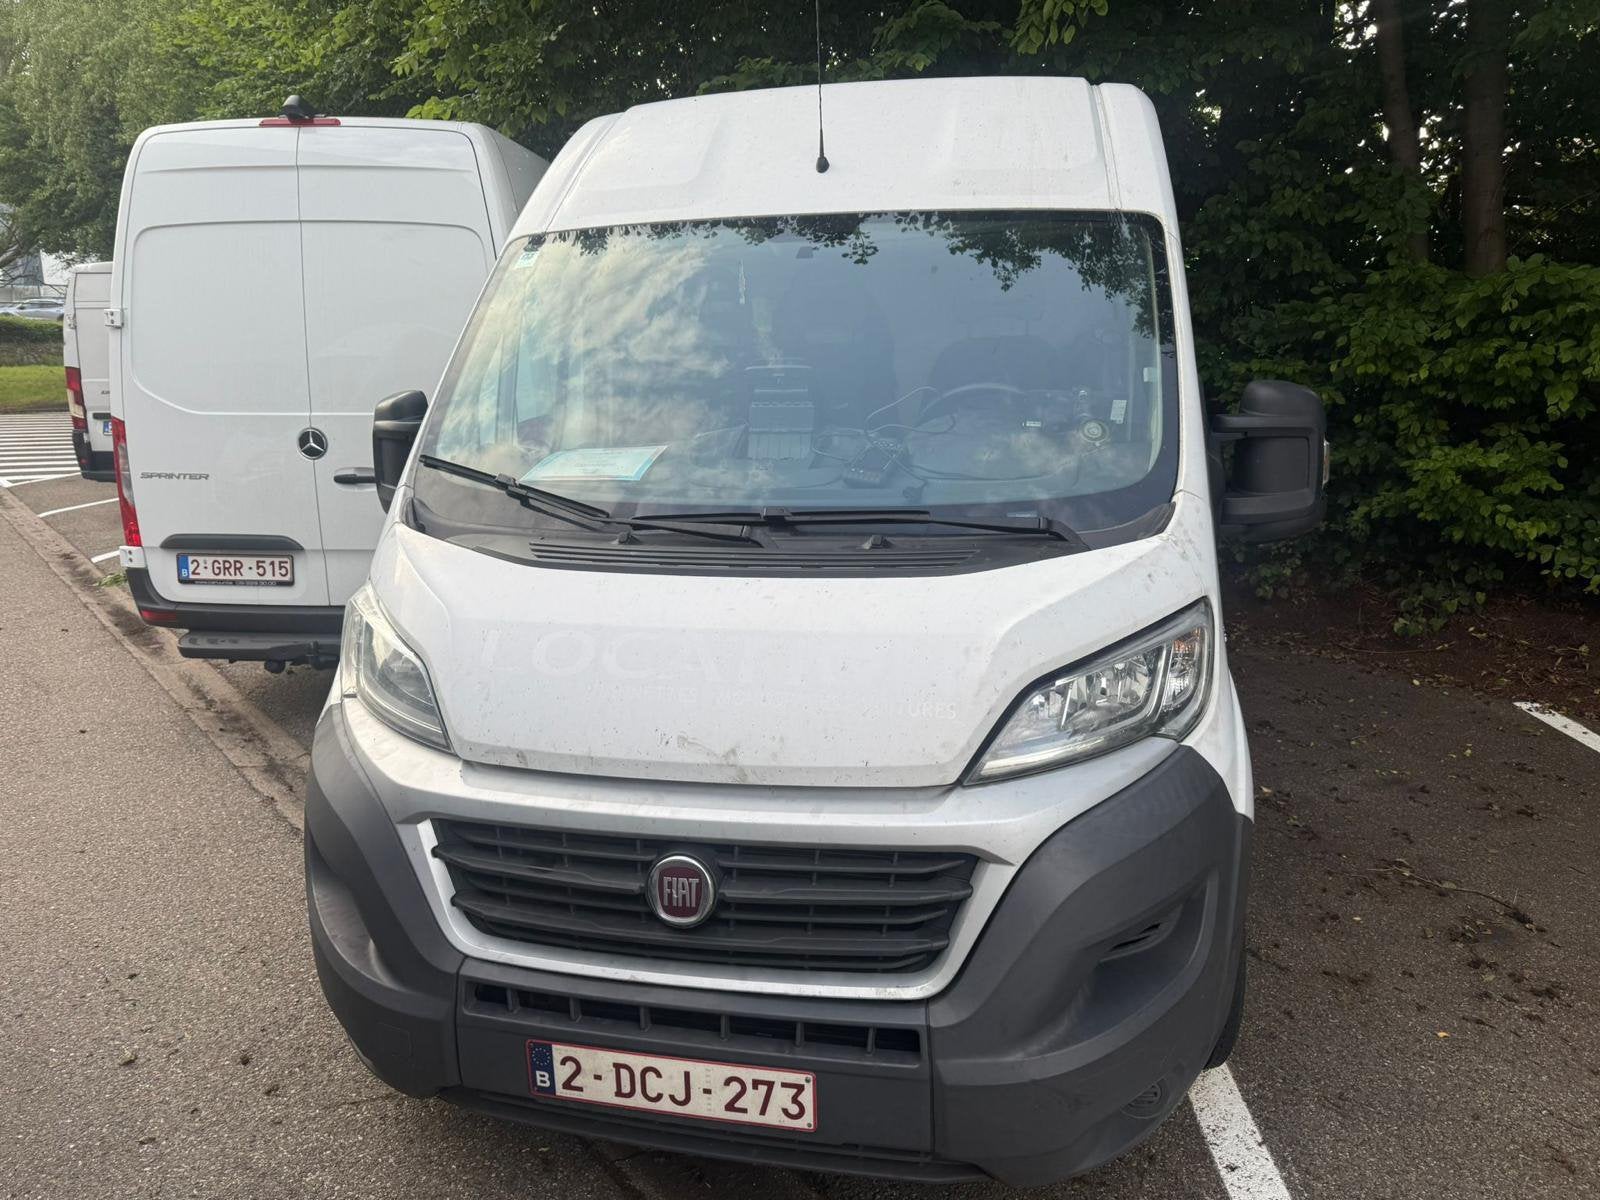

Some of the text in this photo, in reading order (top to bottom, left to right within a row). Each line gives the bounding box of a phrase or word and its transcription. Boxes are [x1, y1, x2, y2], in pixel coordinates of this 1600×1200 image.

[140, 472, 210, 481] SPRINTER
[181, 568, 189, 577] B
[662, 875, 700, 908] FIAT
[535, 1055, 807, 1121] B 2-DCJ-273
